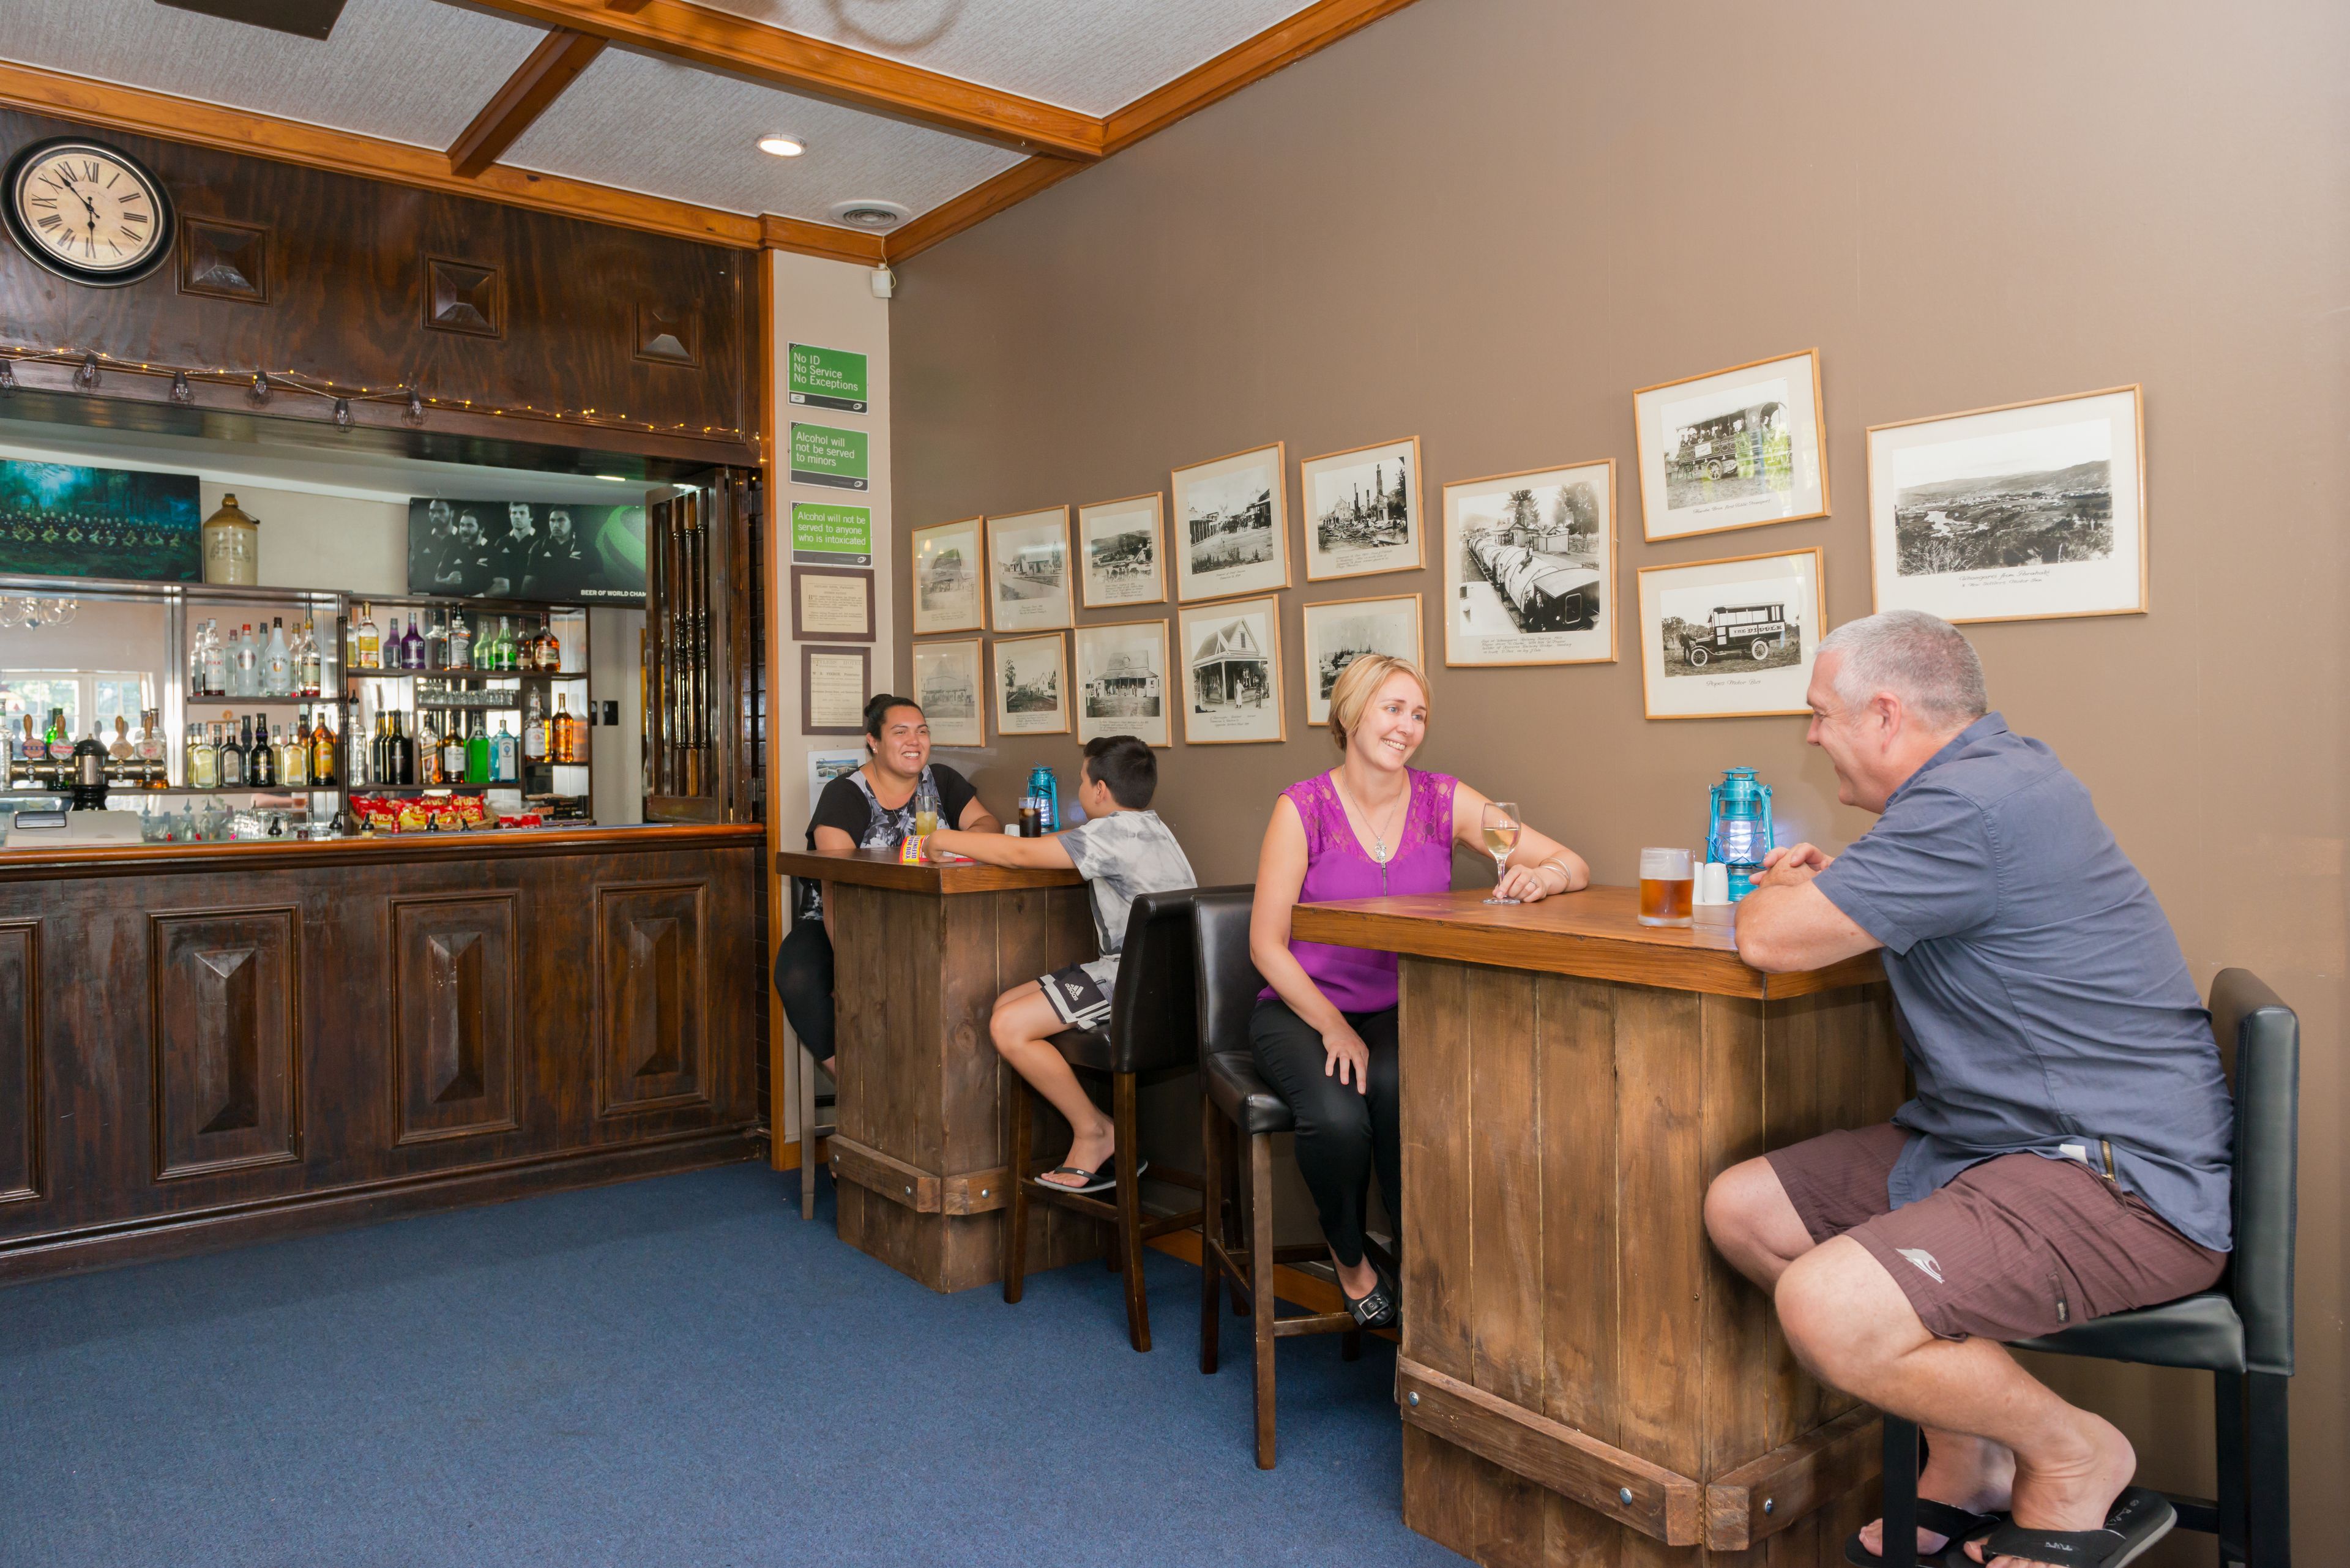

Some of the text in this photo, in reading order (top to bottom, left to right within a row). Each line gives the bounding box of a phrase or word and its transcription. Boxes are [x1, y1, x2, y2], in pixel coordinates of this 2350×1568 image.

[82, 160, 99, 184] XII
[38, 174, 64, 195] X
[794, 353, 820, 365] No ID
[794, 362, 842, 379] No Service
[794, 373, 858, 391] No Exceptions
[796, 431, 845, 447] Alcohol will
[796, 443, 854, 458] not be served
[796, 452, 836, 466] to minors
[798, 511, 866, 525] Alcohol will not be
[836, 526, 862, 536] anyone
[798, 533, 866, 546] who is intoxicated
[1065, 983, 1079, 1001] adidas
